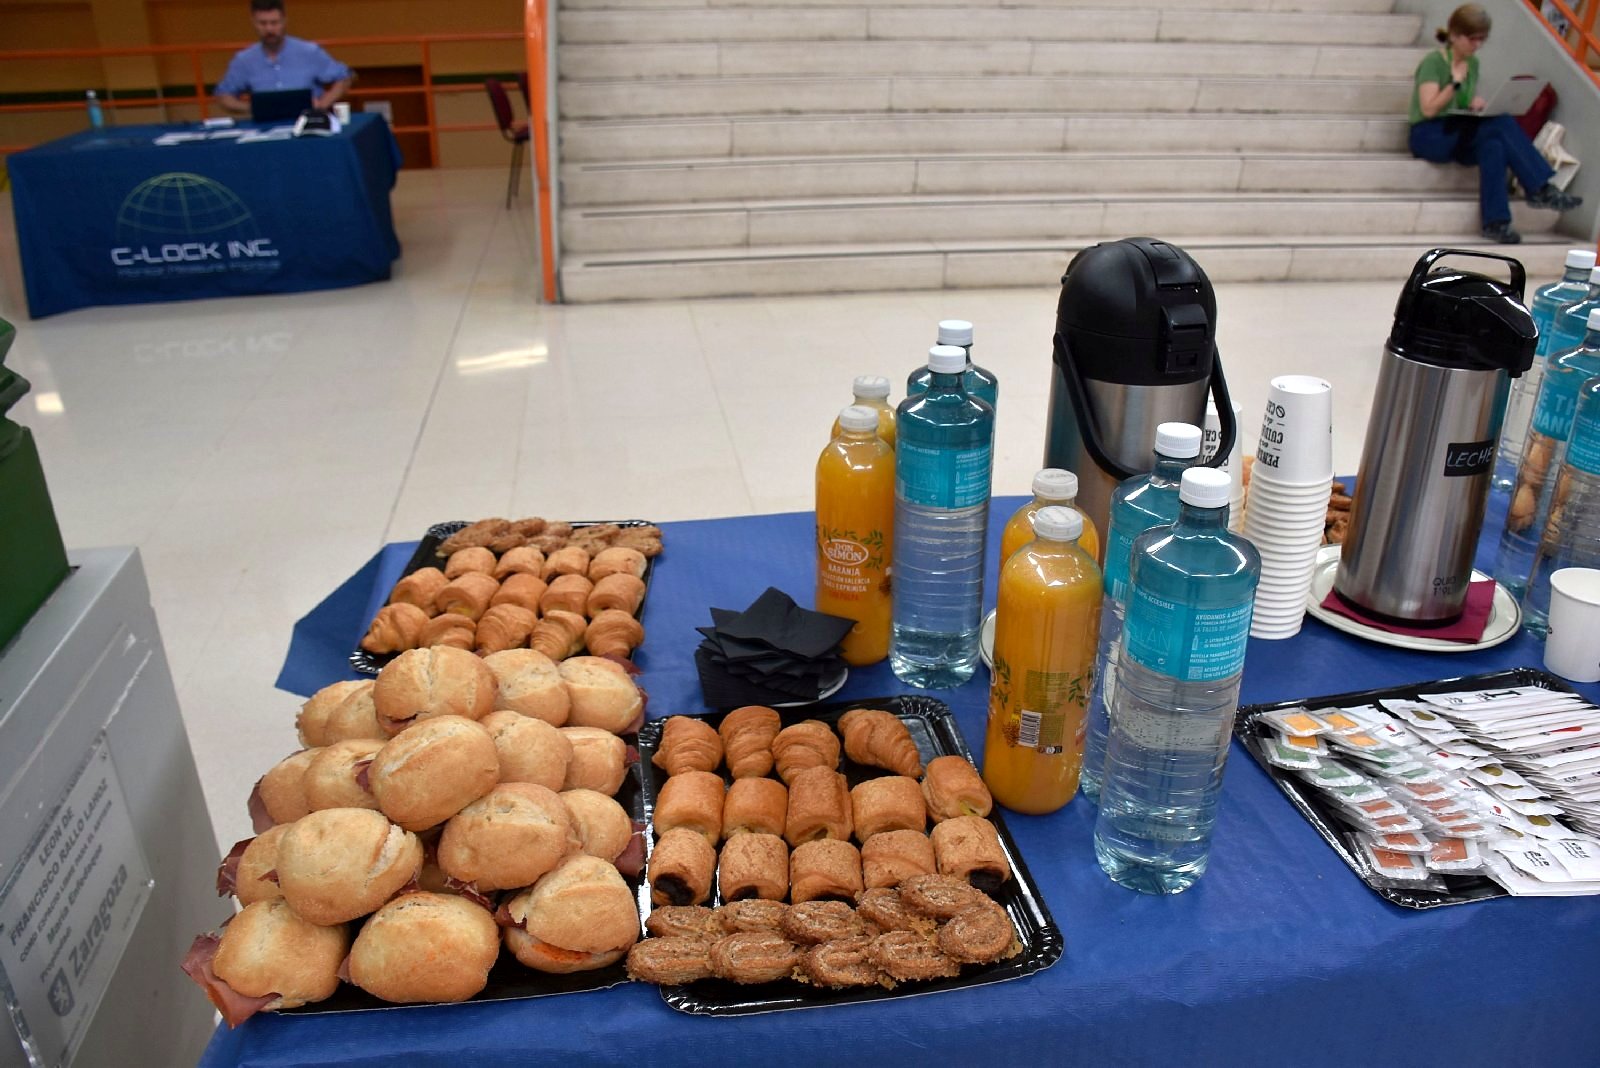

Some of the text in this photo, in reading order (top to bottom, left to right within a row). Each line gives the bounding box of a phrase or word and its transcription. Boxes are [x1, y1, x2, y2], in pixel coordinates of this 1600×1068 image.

[111, 238, 279, 266] C-LOCK INC.
[1446, 446, 1494, 467] LECHE
[835, 543, 854, 552] DON
[828, 563, 860, 576] NARANJA
[1148, 595, 1176, 610] ACCESIBLE
[61, 806, 75, 830] DE
[10, 860, 60, 946] FRANCISCO
[58, 818, 85, 864] RALLO
[68, 863, 128, 978] Zaragoza
